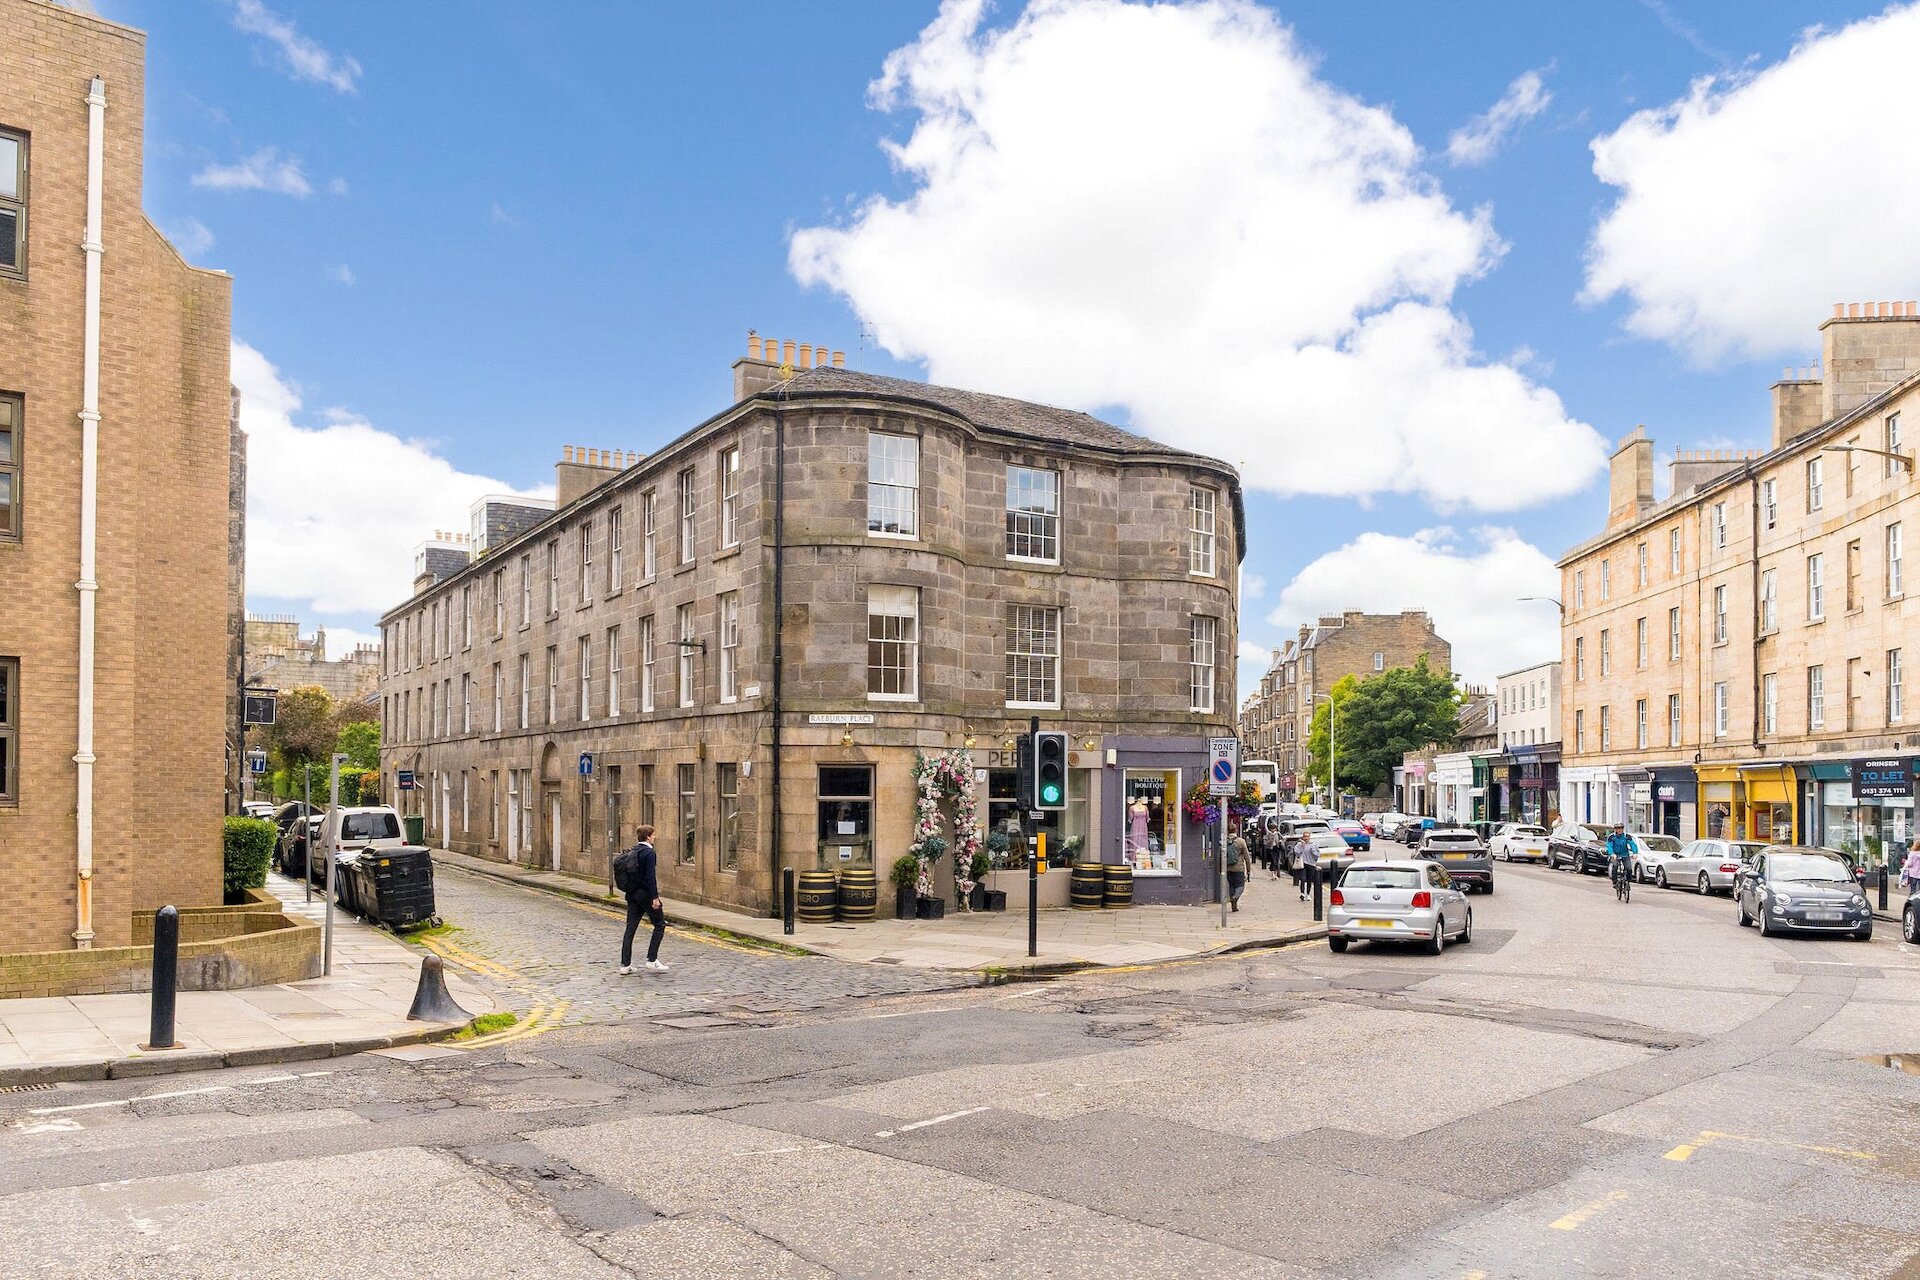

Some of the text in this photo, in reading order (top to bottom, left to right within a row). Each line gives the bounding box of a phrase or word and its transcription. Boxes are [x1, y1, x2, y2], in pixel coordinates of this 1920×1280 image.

[1213, 743, 1234, 751] ZONE
[1861, 771, 1905, 780] TO LET
[1134, 782, 1169, 790] BOUTIQUE
[1861, 787, 1878, 795] 0131
